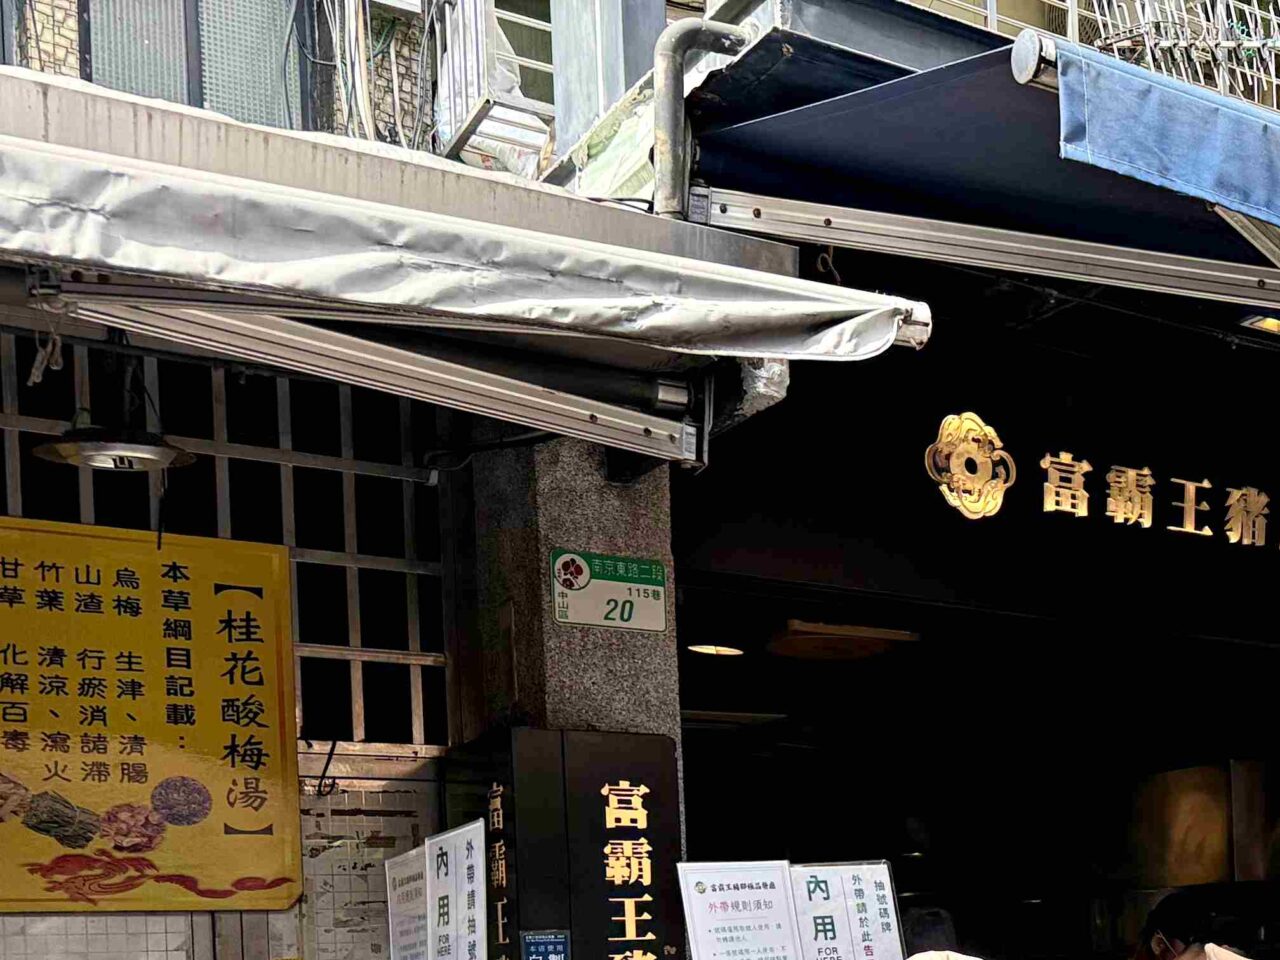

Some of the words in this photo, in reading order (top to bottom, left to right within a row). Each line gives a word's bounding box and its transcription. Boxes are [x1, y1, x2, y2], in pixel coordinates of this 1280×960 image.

[0, 557, 25, 608] 甘草
[34, 560, 65, 612] 竹葉
[75, 563, 105, 616] 山渣
[112, 567, 142, 617] 烏梅
[592, 559, 663, 580] 南京東路二段
[627, 587, 661, 600] 115巷
[604, 598, 634, 622] 20
[0, 643, 29, 752] 化解百毒
[436, 846, 450, 927] 內用
[806, 875, 837, 941] 內用
[874, 880, 892, 934] 抽號碼牌
[438, 934, 450, 946] FOR
[818, 947, 838, 956] FOR
